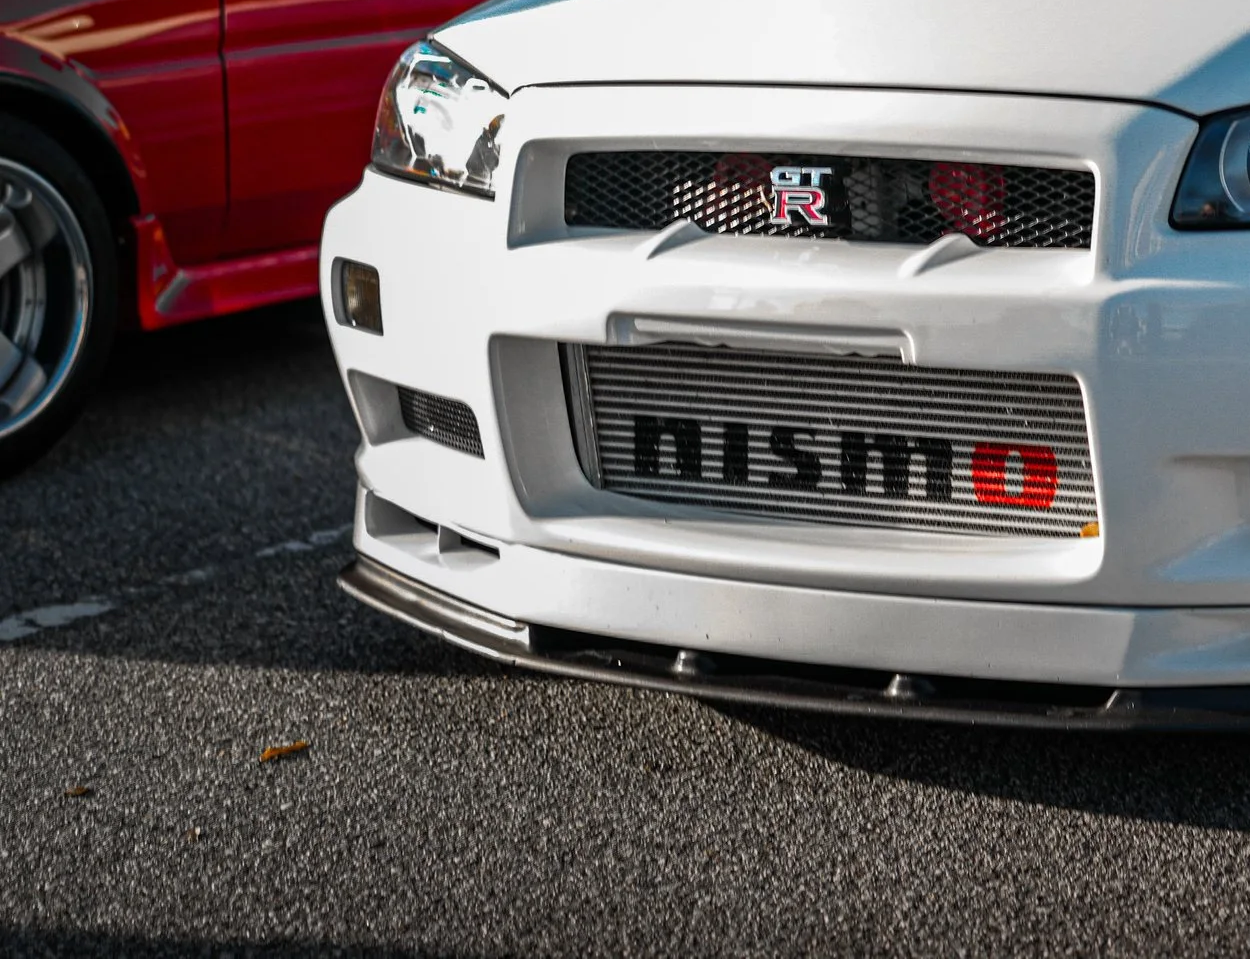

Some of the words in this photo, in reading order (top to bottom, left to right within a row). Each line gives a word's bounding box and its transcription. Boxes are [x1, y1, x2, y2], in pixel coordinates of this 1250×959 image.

[770, 165, 833, 187] GT
[770, 185, 828, 225] R
[633, 415, 1058, 509] nismo
